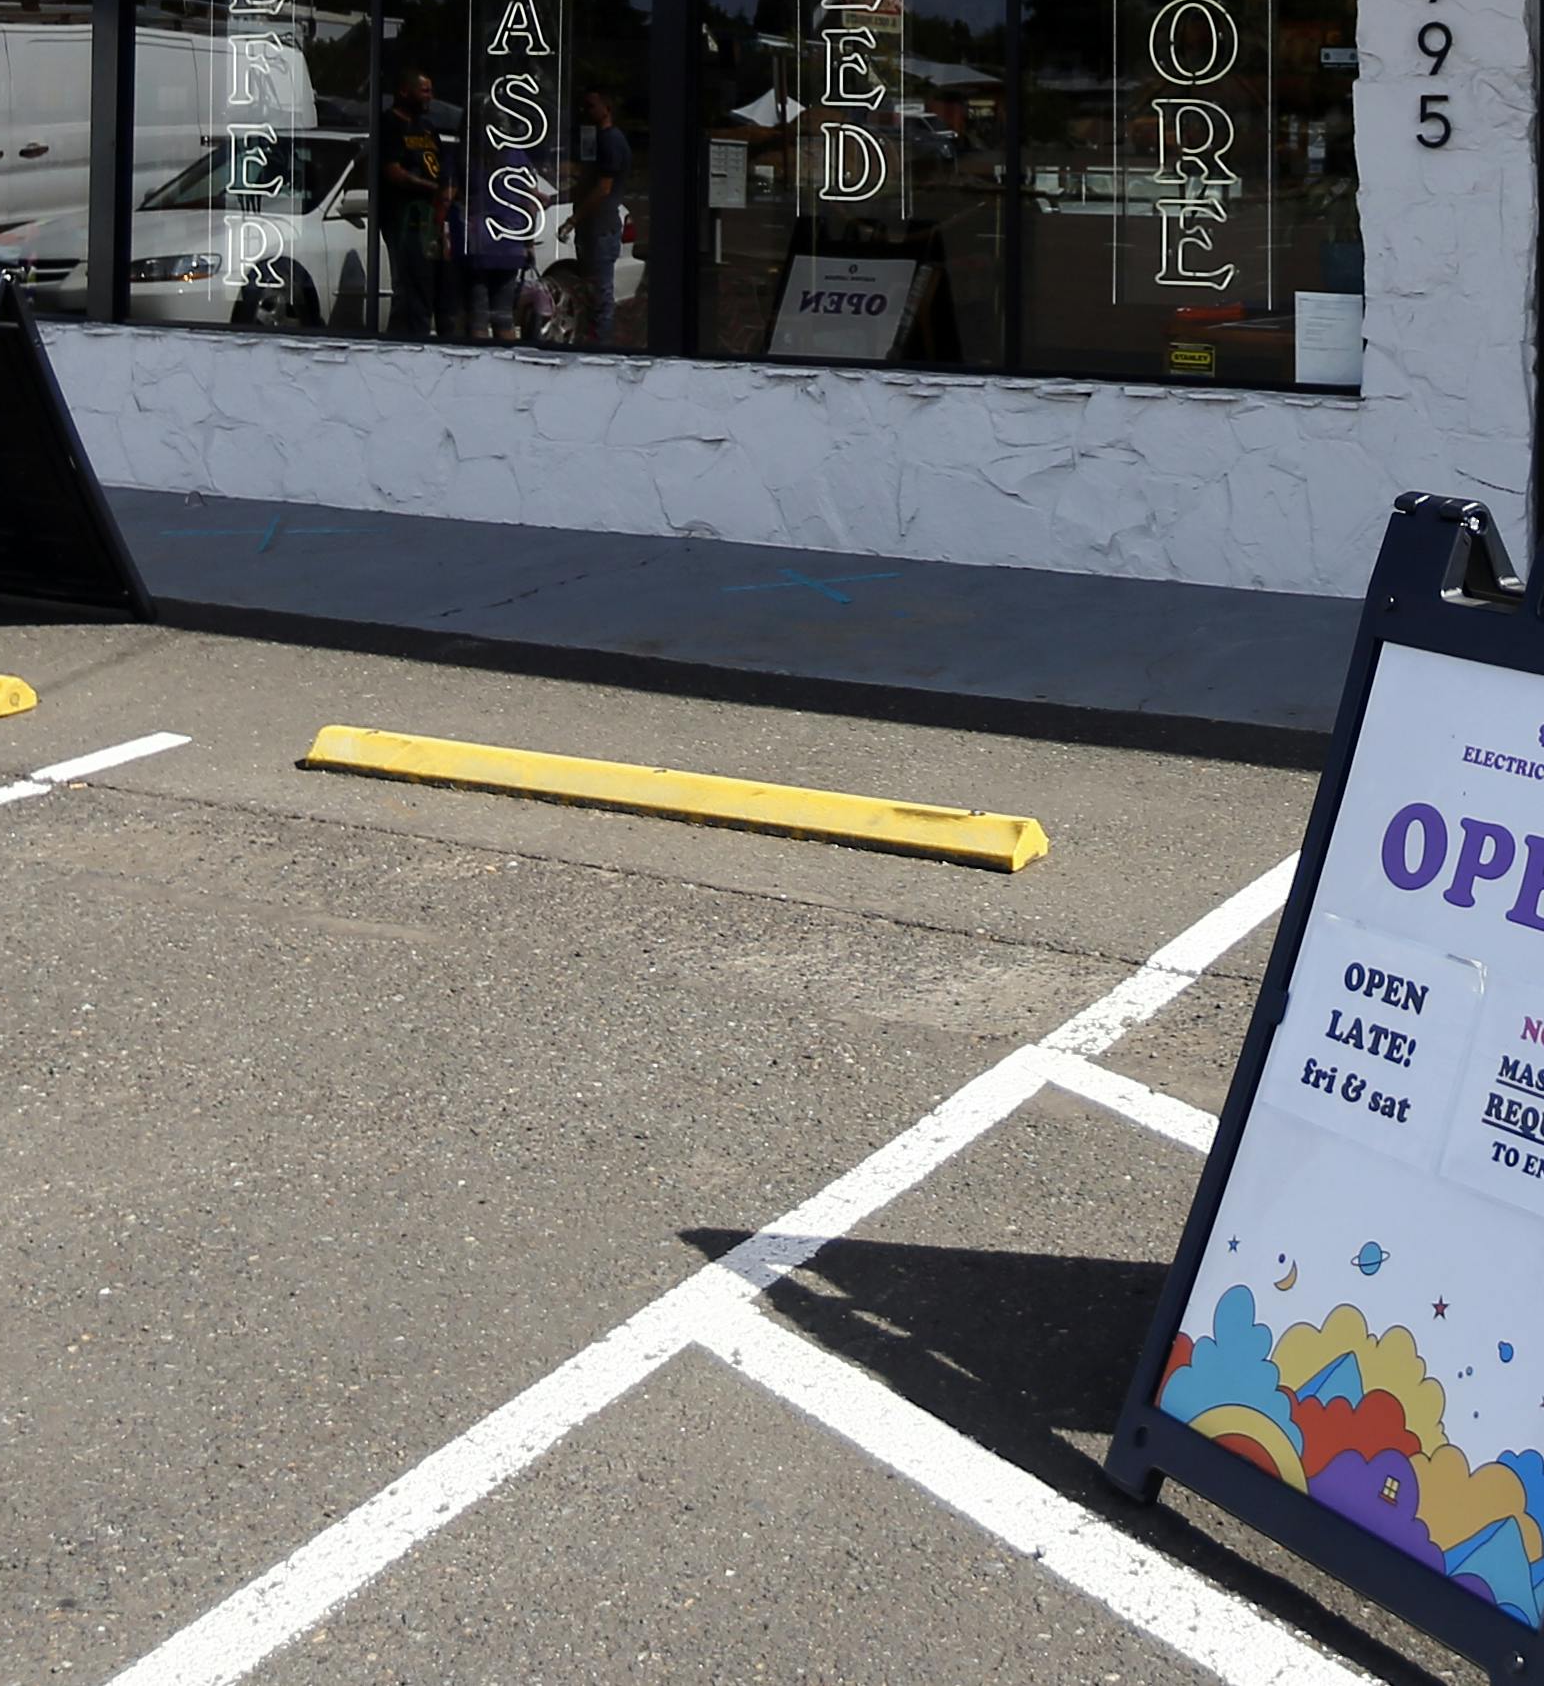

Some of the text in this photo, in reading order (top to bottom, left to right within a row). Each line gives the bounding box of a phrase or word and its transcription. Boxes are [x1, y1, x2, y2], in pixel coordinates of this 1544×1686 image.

[1344, 962, 1429, 1015] OPEN
[1325, 1009, 1417, 1068] LATE!
[1301, 1058, 1411, 1123] fri & sat
[1492, 1141, 1520, 1168] TO
